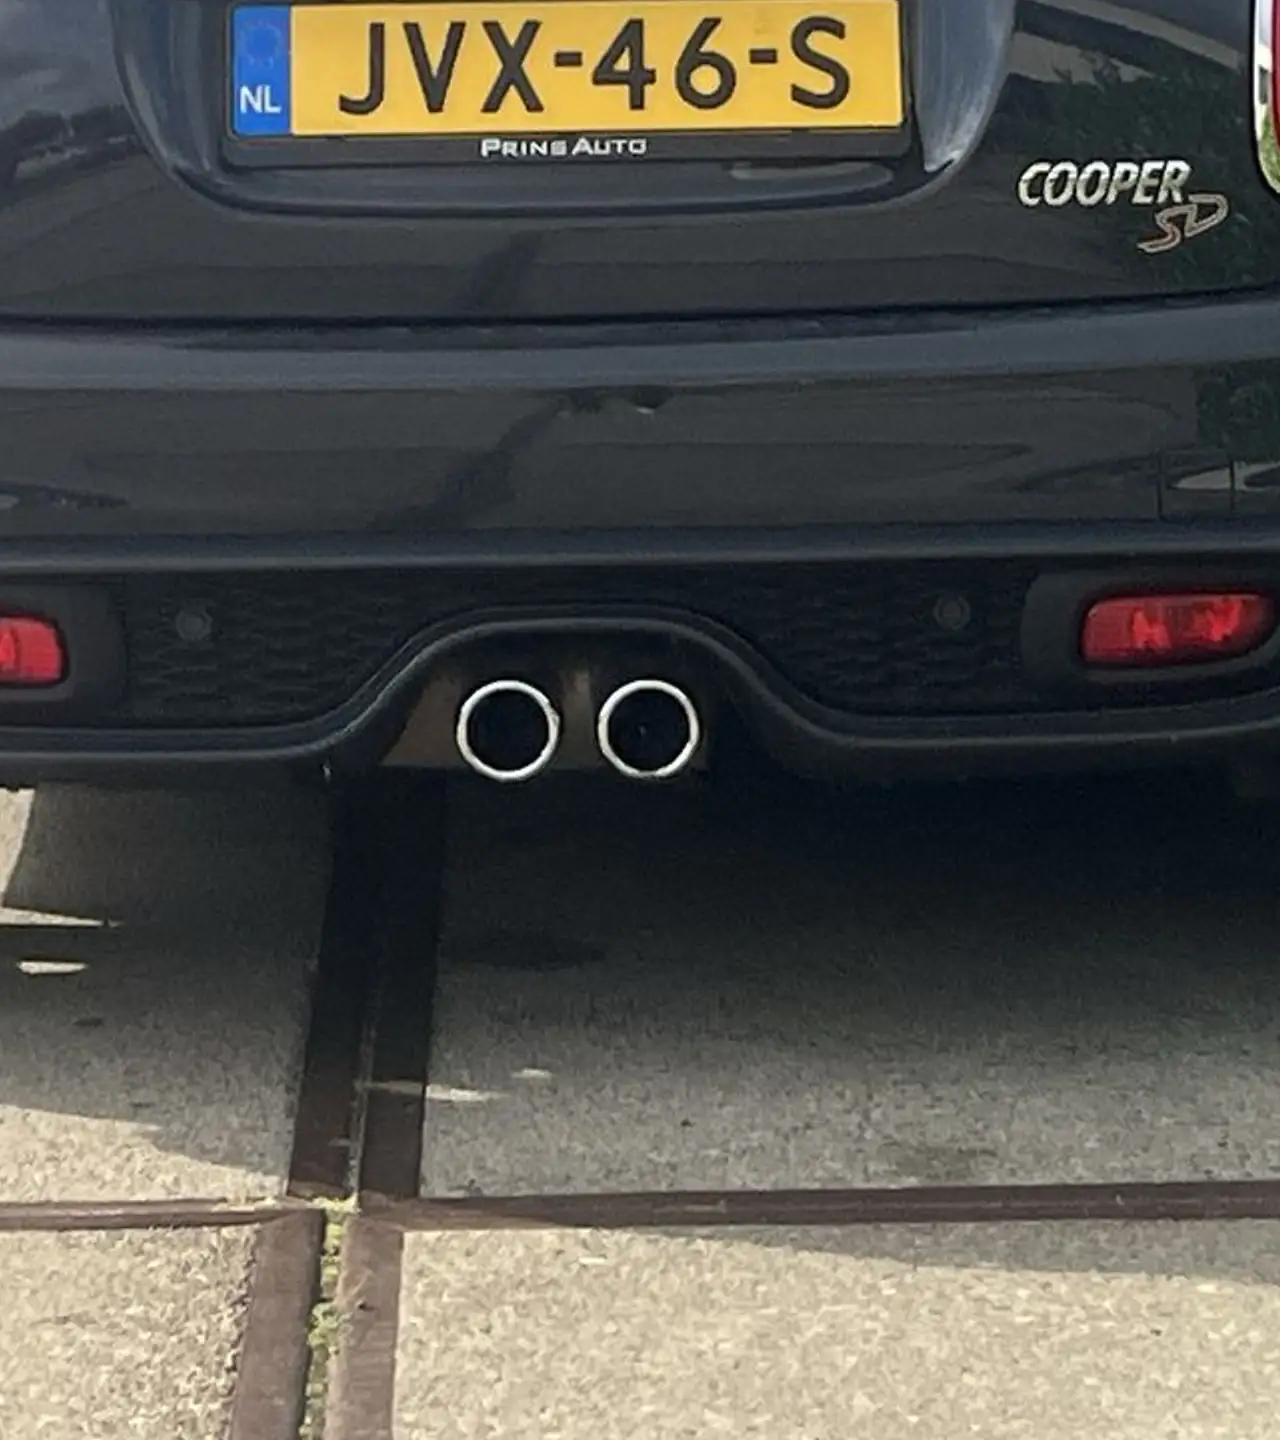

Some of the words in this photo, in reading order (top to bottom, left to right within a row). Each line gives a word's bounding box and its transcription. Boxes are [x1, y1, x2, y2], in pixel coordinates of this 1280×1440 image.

[338, 15, 851, 115] JVX-46-S
[239, 86, 281, 114] NL
[571, 136, 647, 157] AUTO
[1018, 160, 1192, 207] COOPER
[1136, 193, 1230, 254] SD
